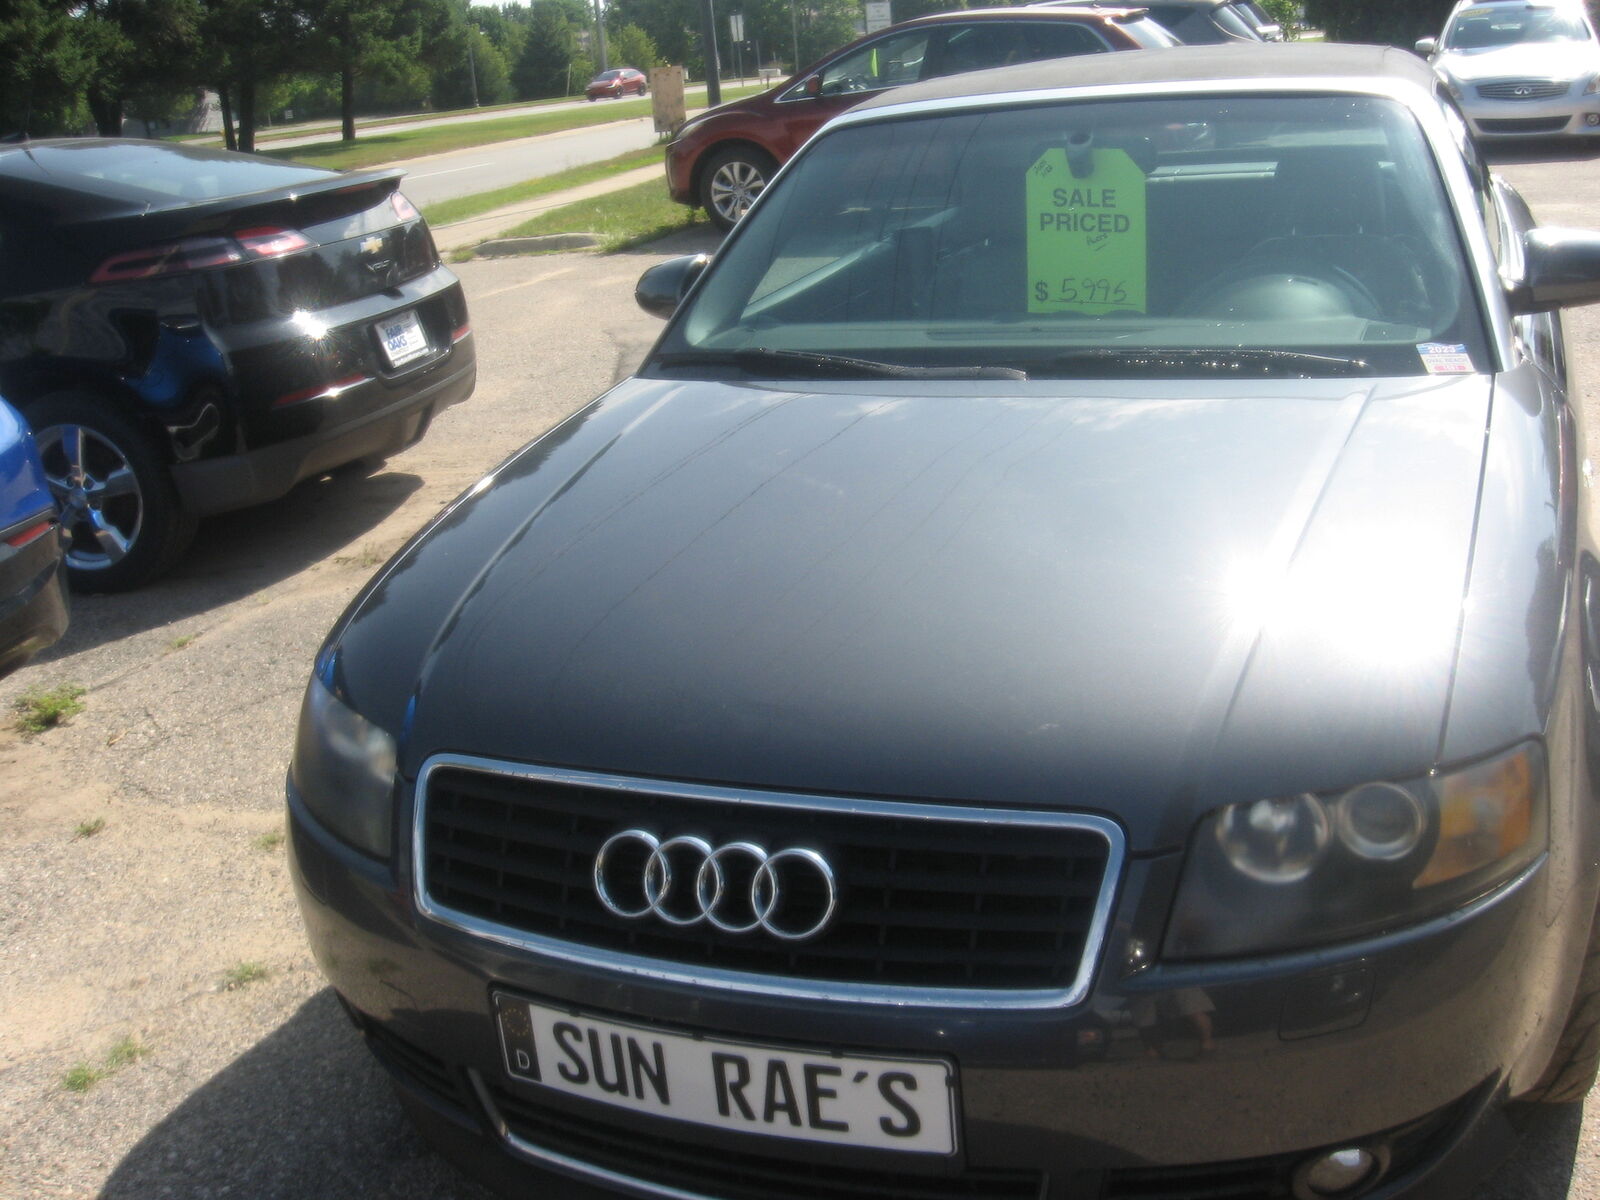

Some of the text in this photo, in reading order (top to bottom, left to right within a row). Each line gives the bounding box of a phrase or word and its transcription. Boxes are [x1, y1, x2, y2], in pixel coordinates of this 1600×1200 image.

[1053, 188, 1117, 208] SALE
[1040, 213, 1131, 233] PRICED
[1035, 280, 1049, 302] $
[387, 335, 408, 351] OAKS
[515, 1049, 531, 1071] D
[552, 1021, 671, 1106] SUN
